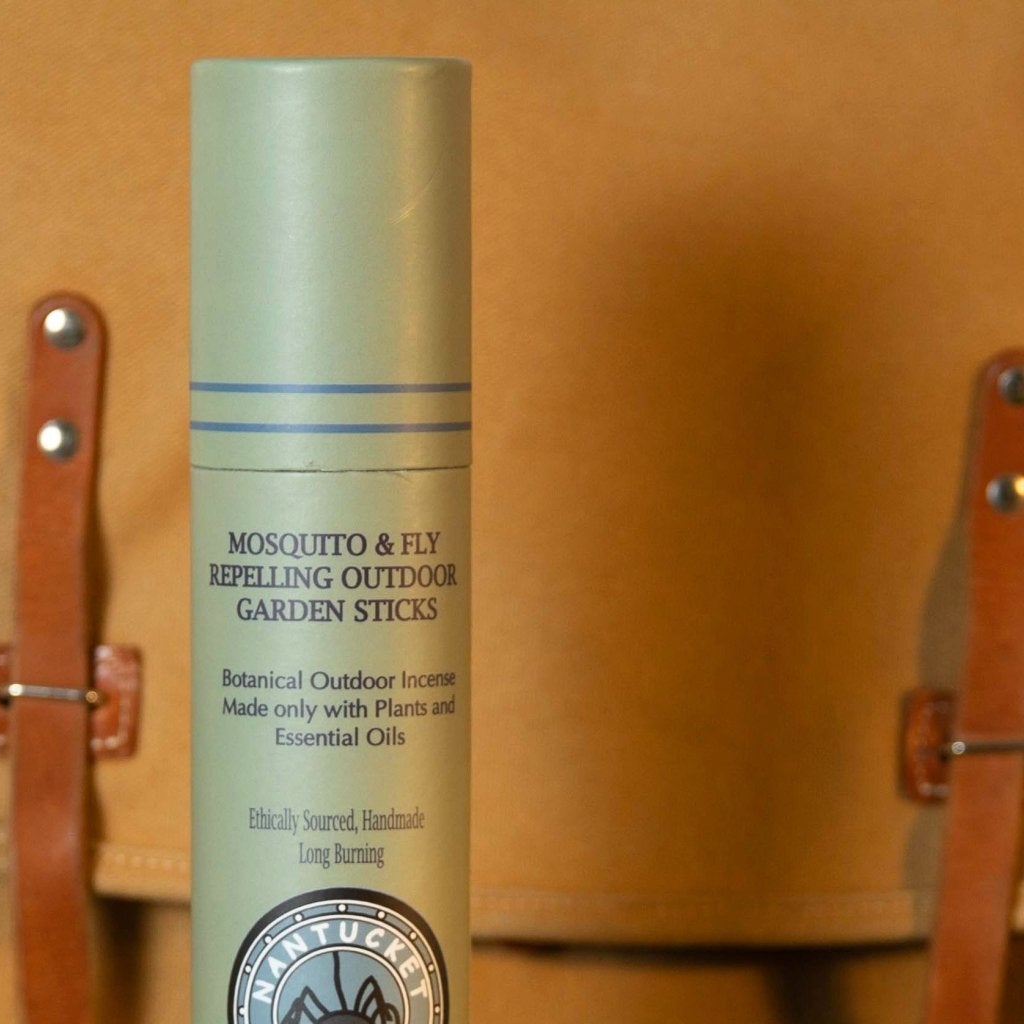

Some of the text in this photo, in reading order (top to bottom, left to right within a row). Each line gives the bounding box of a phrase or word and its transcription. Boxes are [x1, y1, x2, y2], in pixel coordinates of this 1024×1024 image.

[228, 531, 441, 559] MOSQUITO & FLY
[209, 563, 457, 589] REPELLING OUTDOOR
[236, 597, 438, 622] GARDEN STICKS
[222, 668, 456, 690] Botanical Outdoor Incense
[222, 694, 456, 723] Made only with Plants and
[275, 727, 406, 746] Essential Oils
[248, 807, 425, 836] Ethically Sourced, Handmade
[298, 842, 384, 869] Long Burning
[252, 921, 427, 1004] NANTUCKET
